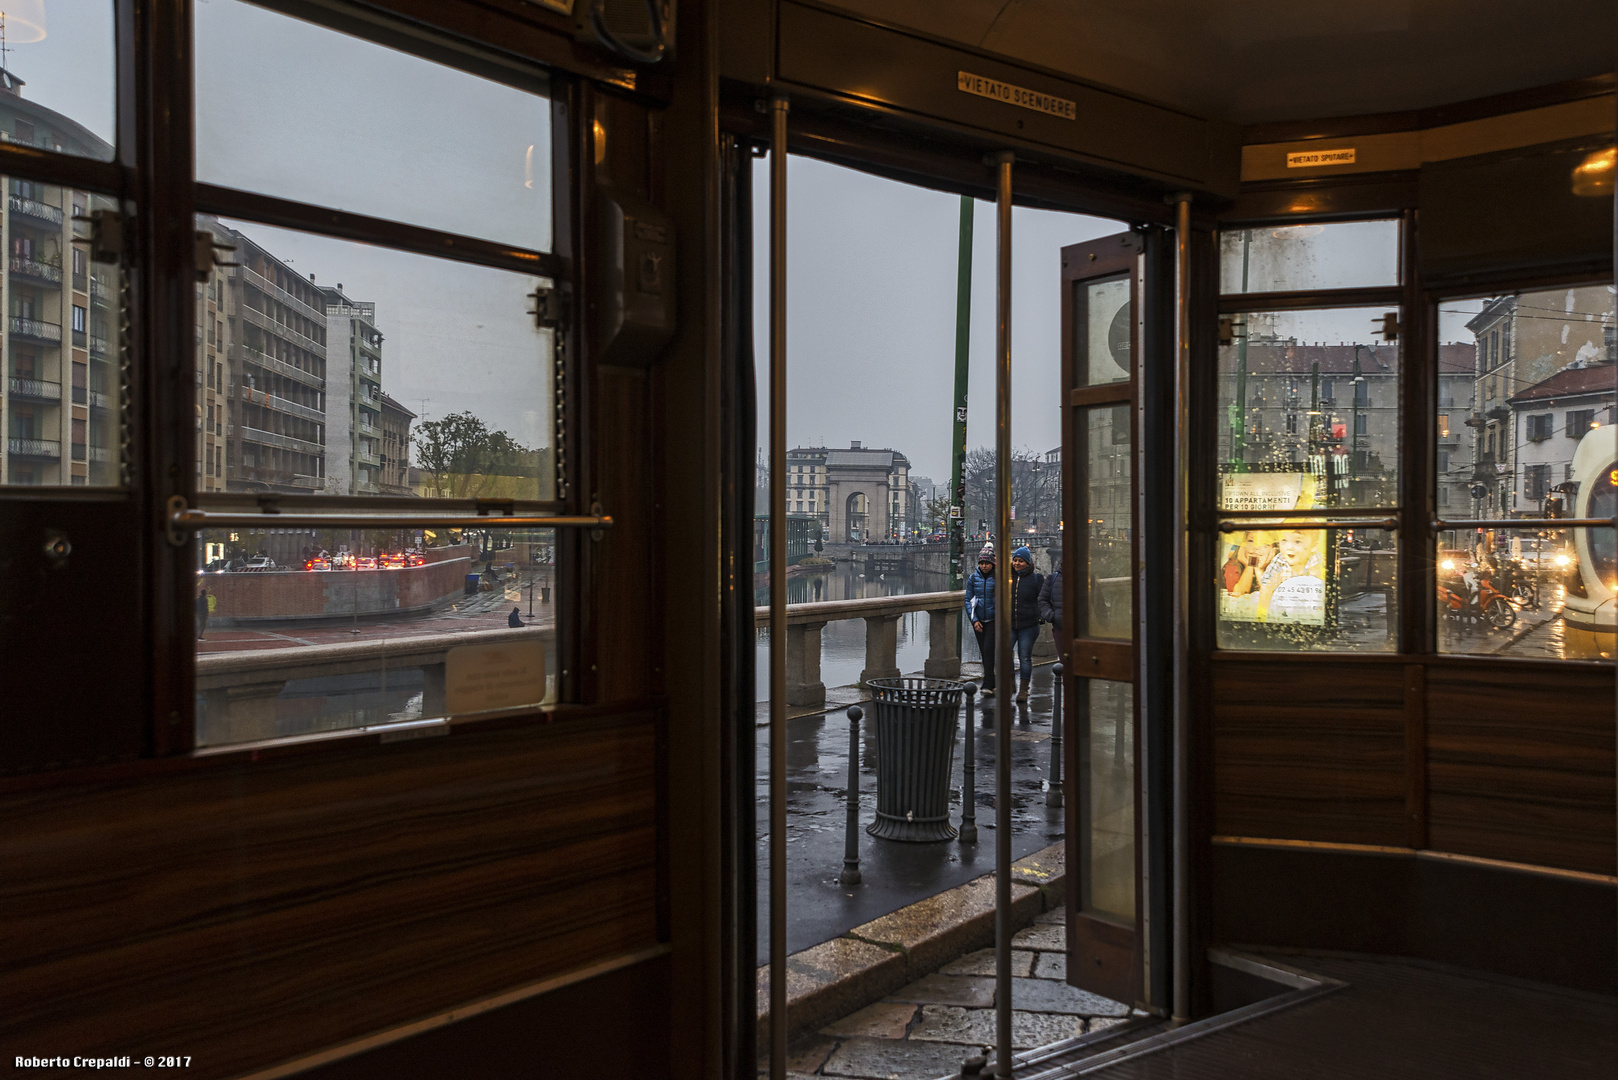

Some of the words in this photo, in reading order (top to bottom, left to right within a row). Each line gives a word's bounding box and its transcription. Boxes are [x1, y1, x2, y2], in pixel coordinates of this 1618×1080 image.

[964, 75, 1010, 100] VIETATO
[1014, 89, 1070, 116] SCENDERE
[1293, 155, 1318, 163] VIETATO
[1320, 152, 1349, 162] SPUTARE
